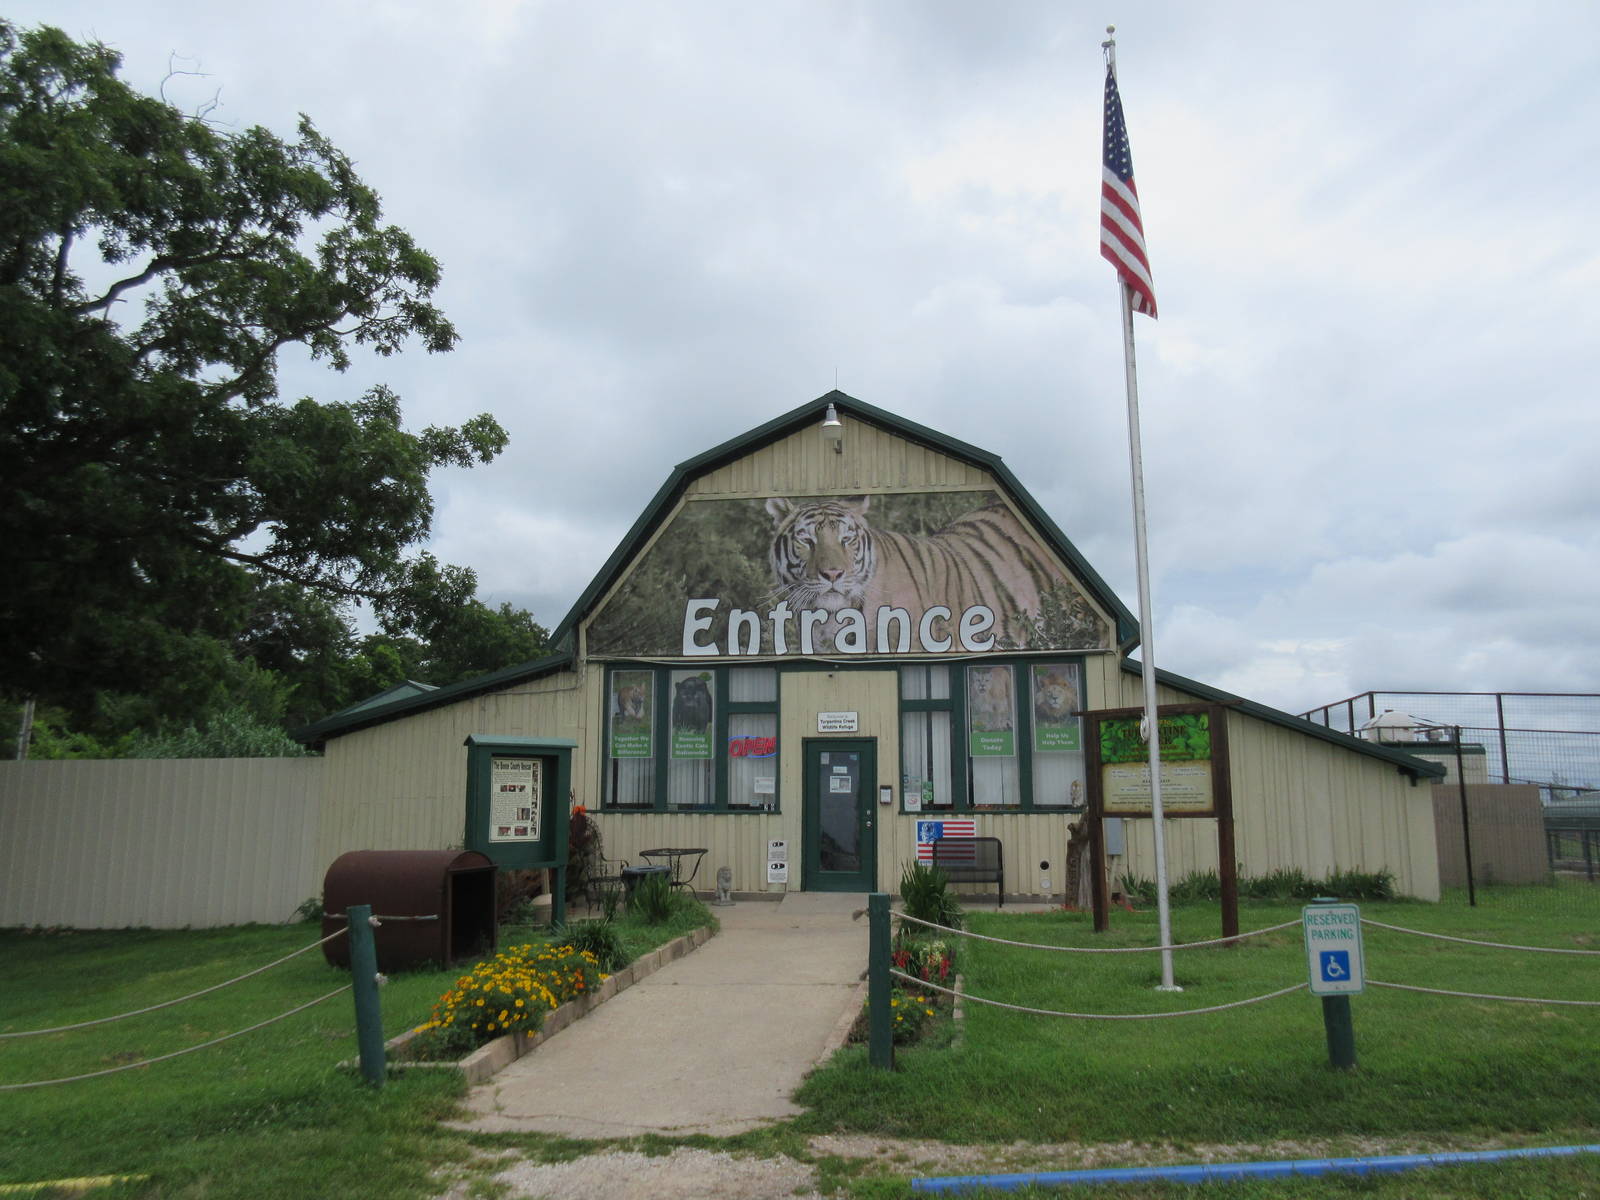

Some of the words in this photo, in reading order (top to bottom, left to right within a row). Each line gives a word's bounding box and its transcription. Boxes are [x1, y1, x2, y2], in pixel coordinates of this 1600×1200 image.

[682, 597, 997, 656] Entrance
[729, 736, 776, 757] OPEN
[510, 761, 520, 772] County
[1307, 912, 1354, 925] RESERVED
[1312, 928, 1354, 940] PARKING
